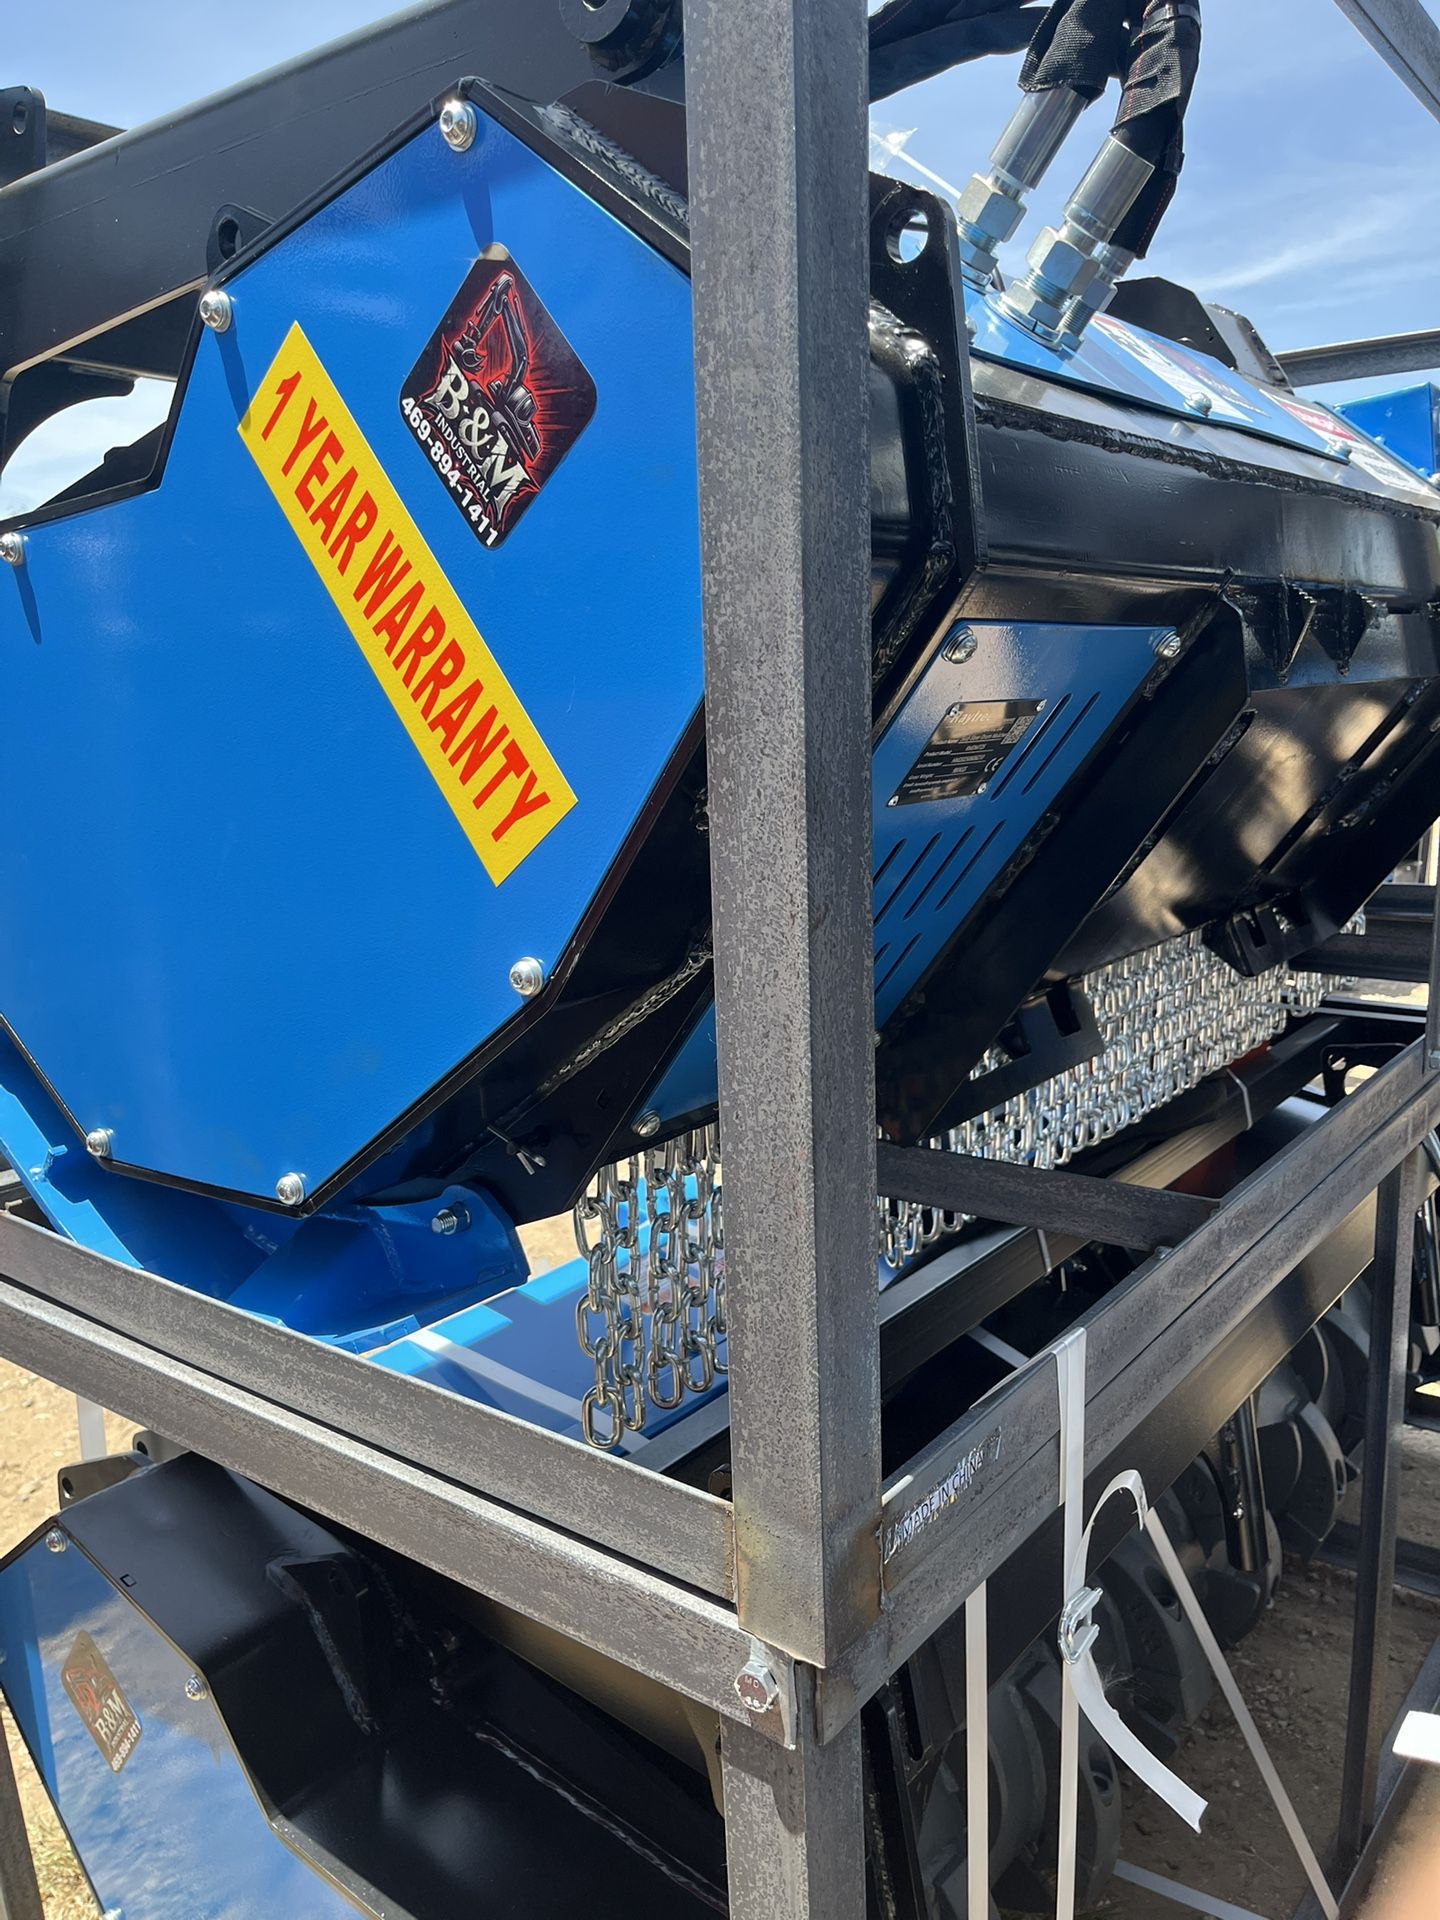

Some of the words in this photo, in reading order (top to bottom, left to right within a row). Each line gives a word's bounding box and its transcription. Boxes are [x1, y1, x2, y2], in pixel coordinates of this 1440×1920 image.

[261, 371, 302, 441] 1
[434, 411, 491, 503] INDUSTRIAL
[280, 399, 378, 575] YEAR
[400, 396, 499, 548] 469-894-1411
[351, 528, 551, 843] WARRANTY
[903, 1495, 936, 1539] MADE
[937, 1484, 951, 1505] IN
[952, 1448, 984, 1492] CHINA
